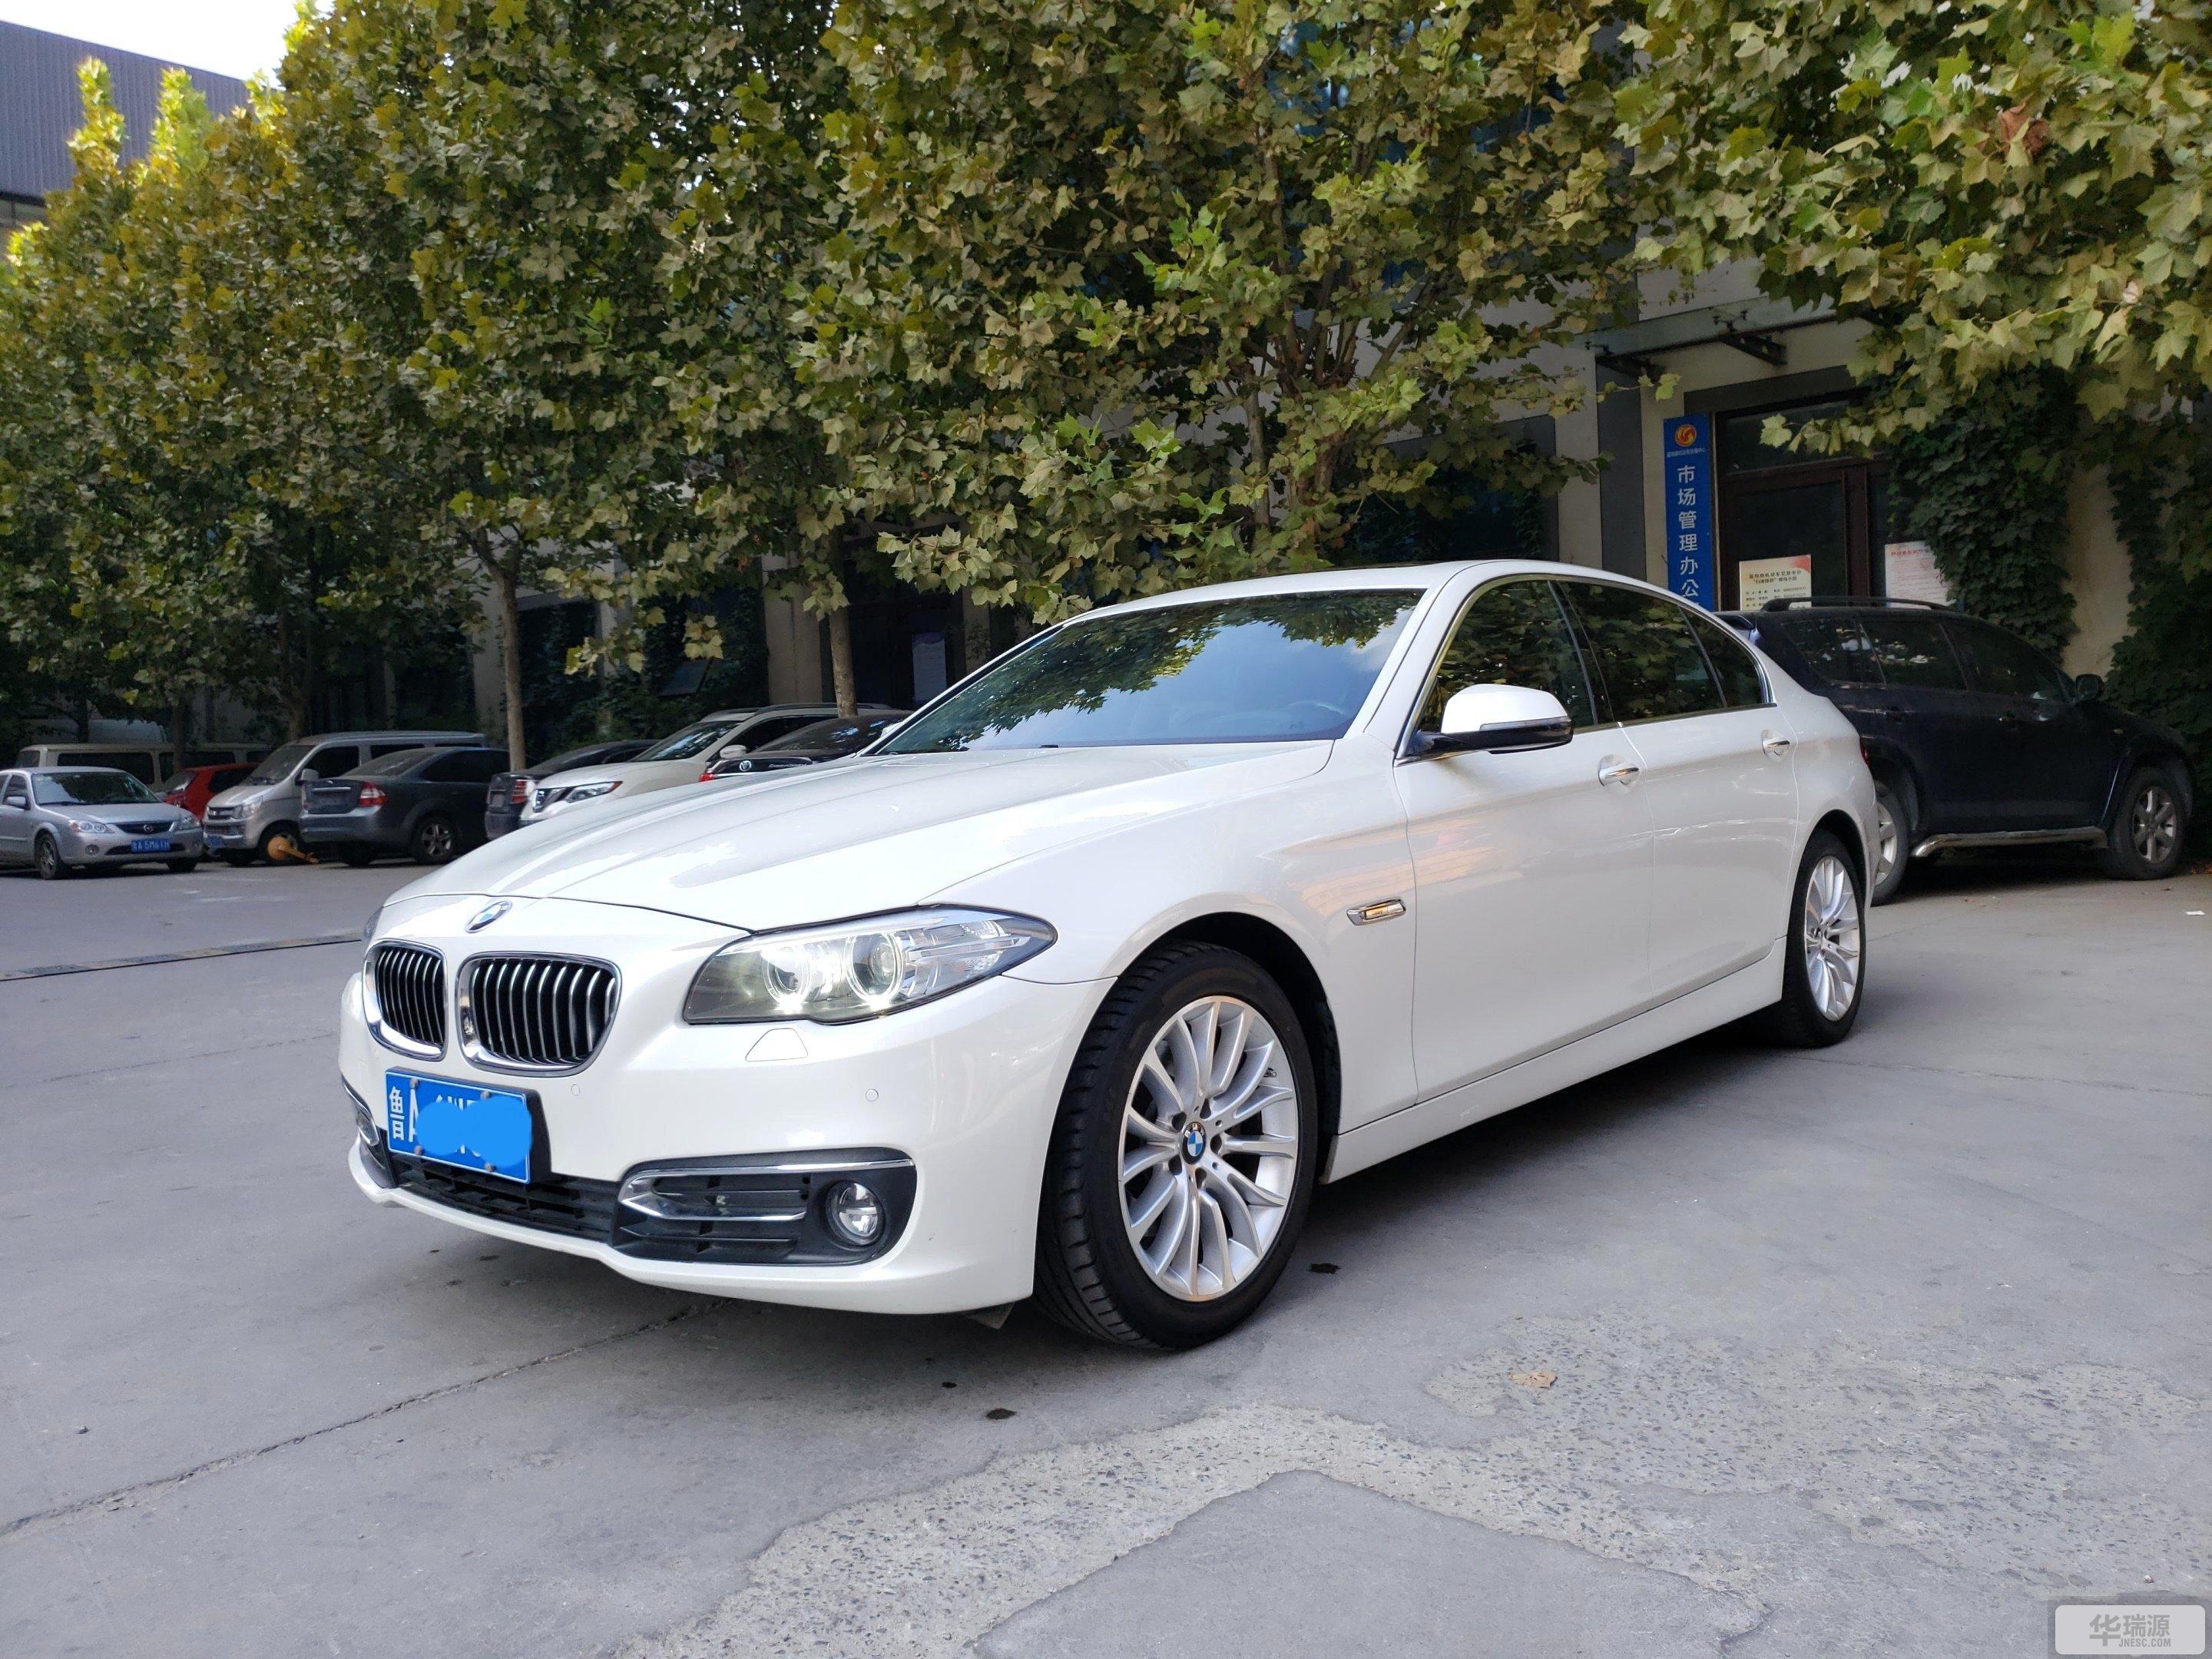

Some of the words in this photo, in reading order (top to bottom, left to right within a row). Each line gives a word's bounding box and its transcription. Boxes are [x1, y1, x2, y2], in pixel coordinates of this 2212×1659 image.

[1677, 465, 1699, 606] 市场管理办公
